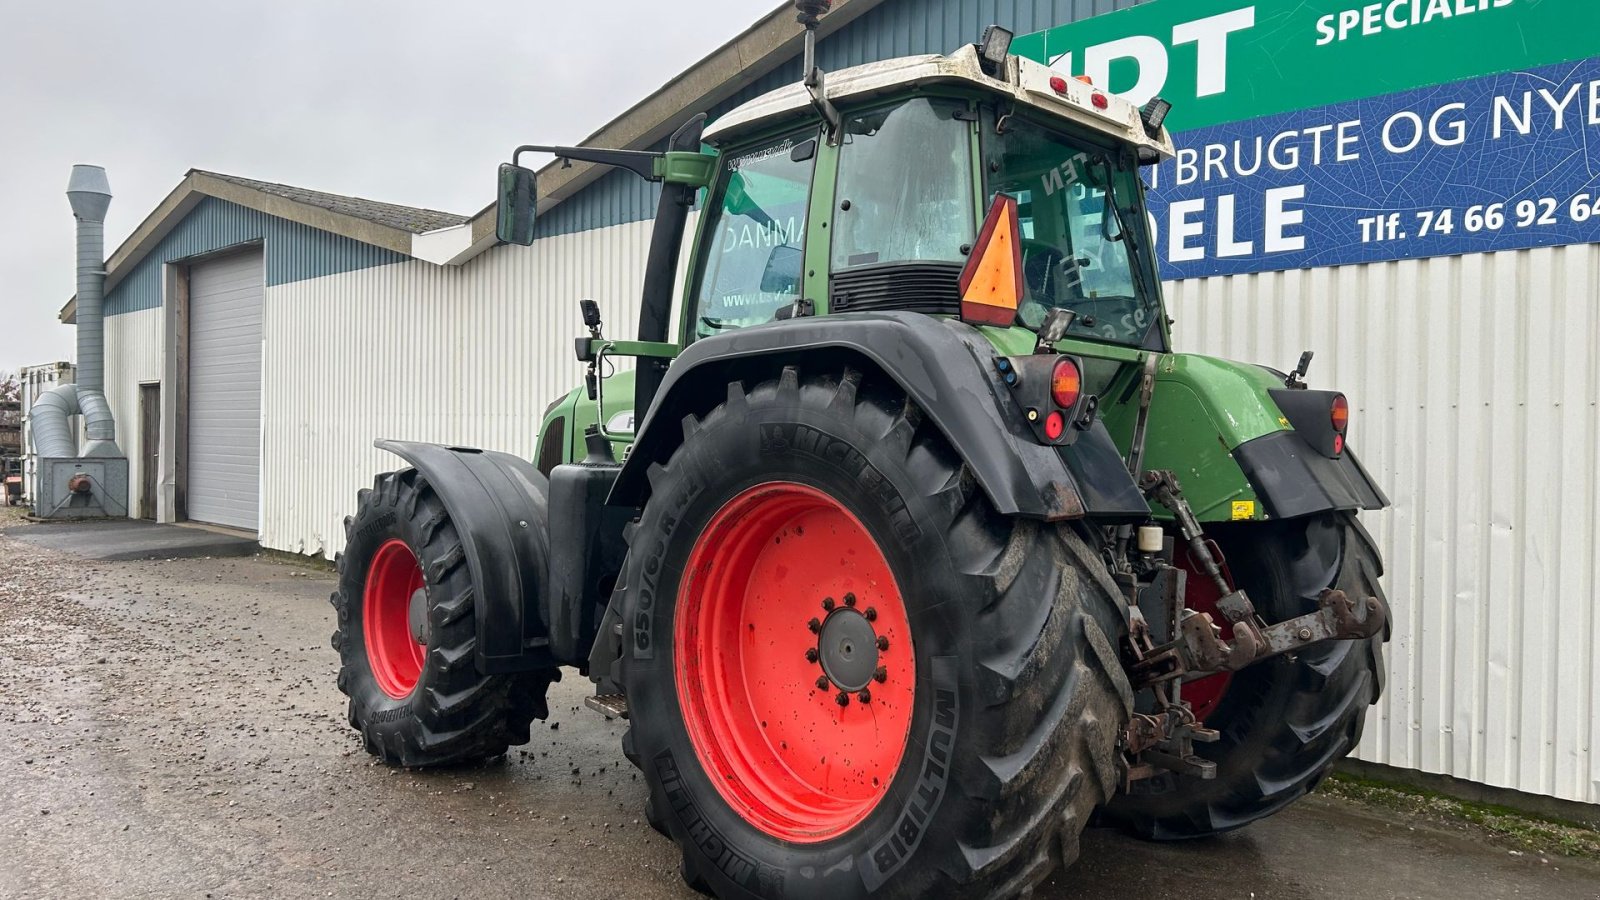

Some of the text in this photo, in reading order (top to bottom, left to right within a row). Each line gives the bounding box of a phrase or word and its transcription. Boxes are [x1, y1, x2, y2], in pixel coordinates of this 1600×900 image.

[1315, 0, 1513, 46] SPECIAL
[1176, 119, 1361, 186] BRUGTE
[1381, 102, 1466, 154] OG
[1147, 184, 1305, 276] ELE
[1357, 212, 1406, 243] Tlf.
[1416, 208, 1454, 237] 74
[1464, 203, 1505, 232] 66
[1516, 197, 1558, 228] 92
[871, 689, 956, 875] MULTIBIB
